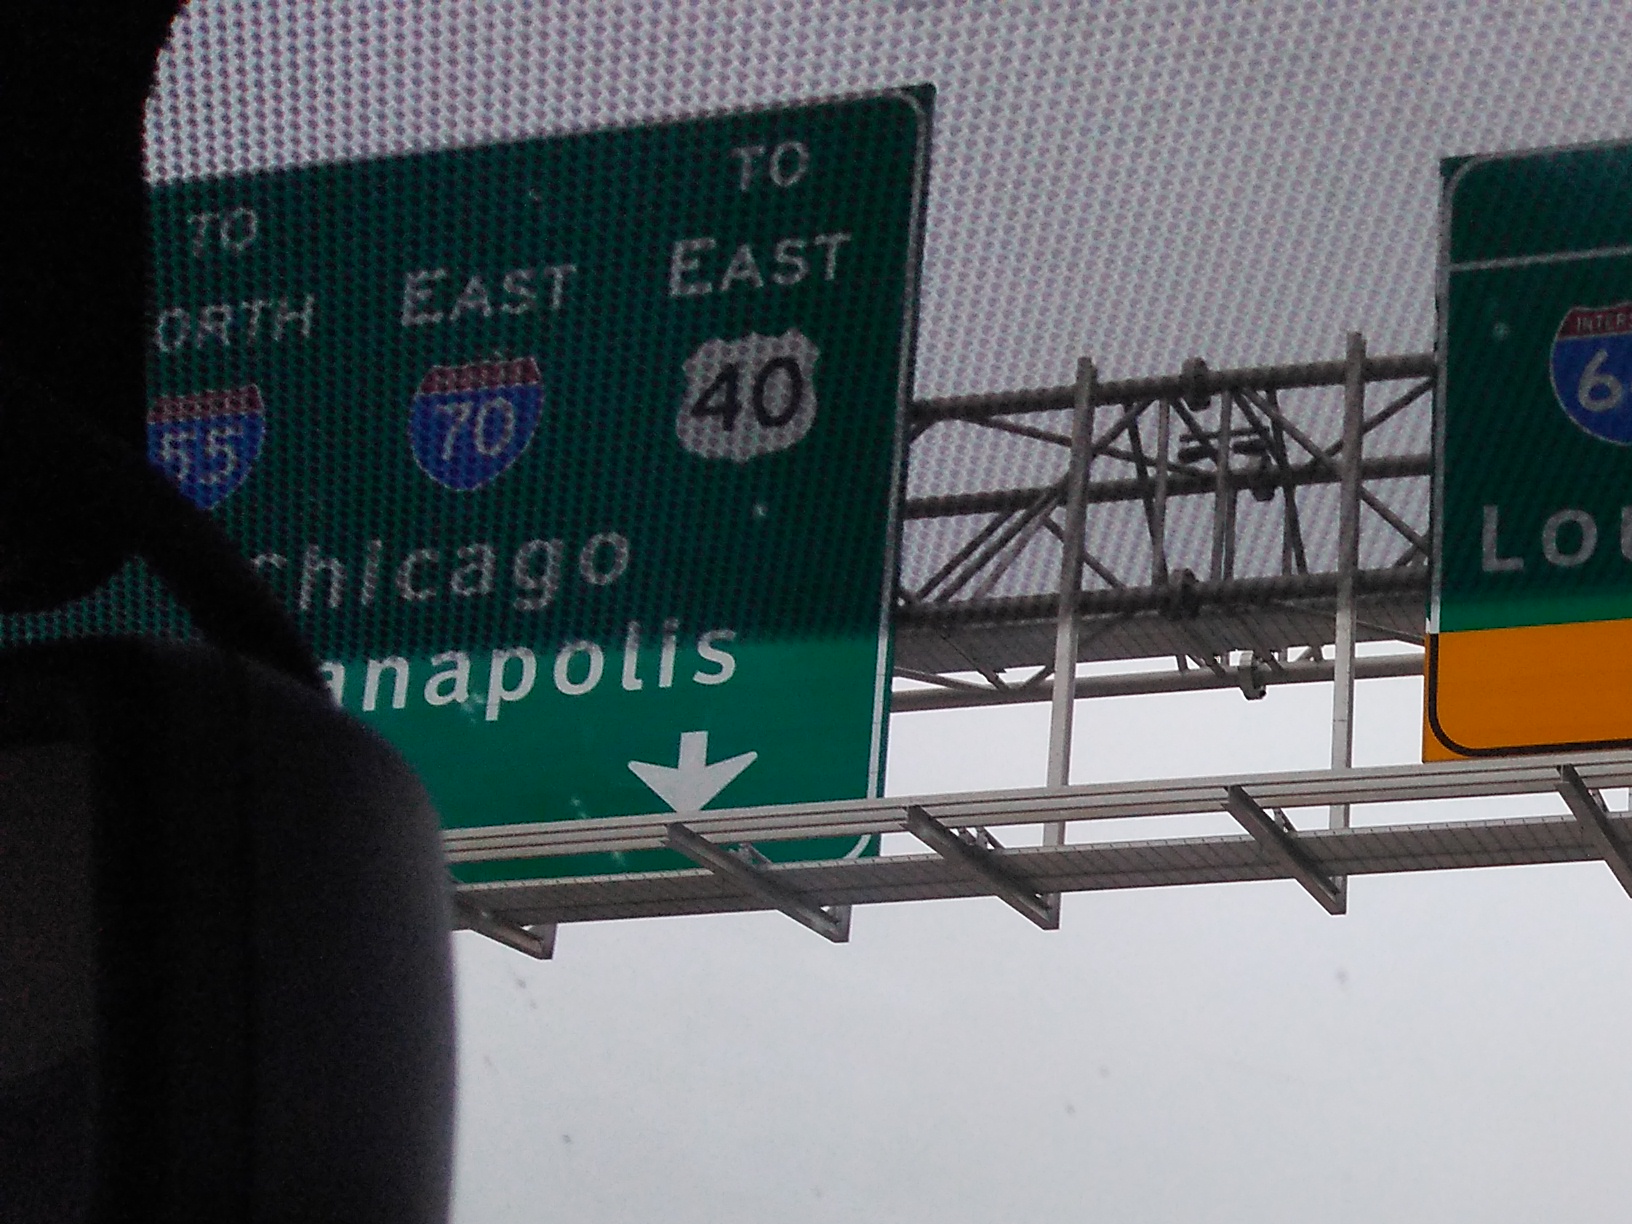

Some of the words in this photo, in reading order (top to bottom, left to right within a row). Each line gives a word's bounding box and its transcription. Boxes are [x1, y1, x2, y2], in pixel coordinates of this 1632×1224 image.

[732, 141, 809, 193] TO
[188, 206, 258, 256] TO
[401, 264, 577, 327] EAST
[669, 232, 851, 297] EAST
[153, 292, 314, 352] ORTH
[689, 356, 802, 432] 40
[160, 425, 243, 486] 55
[435, 397, 515, 460] 70
[318, 616, 738, 722] anapolis
